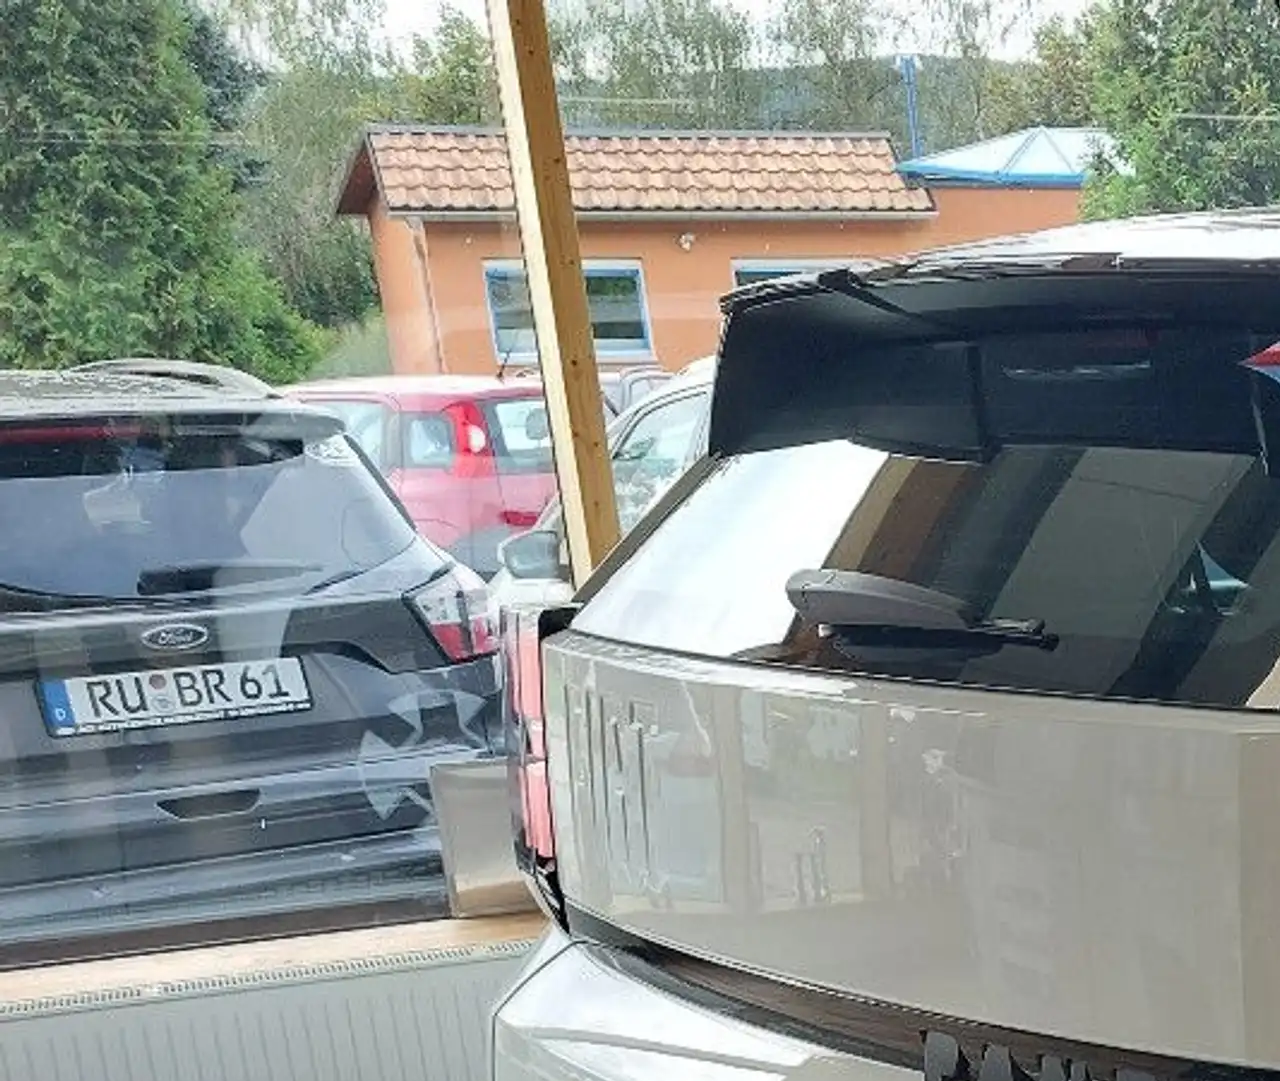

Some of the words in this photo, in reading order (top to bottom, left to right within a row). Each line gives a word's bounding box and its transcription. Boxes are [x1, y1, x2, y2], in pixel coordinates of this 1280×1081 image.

[85, 675, 149, 718] RU
[172, 668, 233, 707] BR
[238, 663, 291, 700] 61
